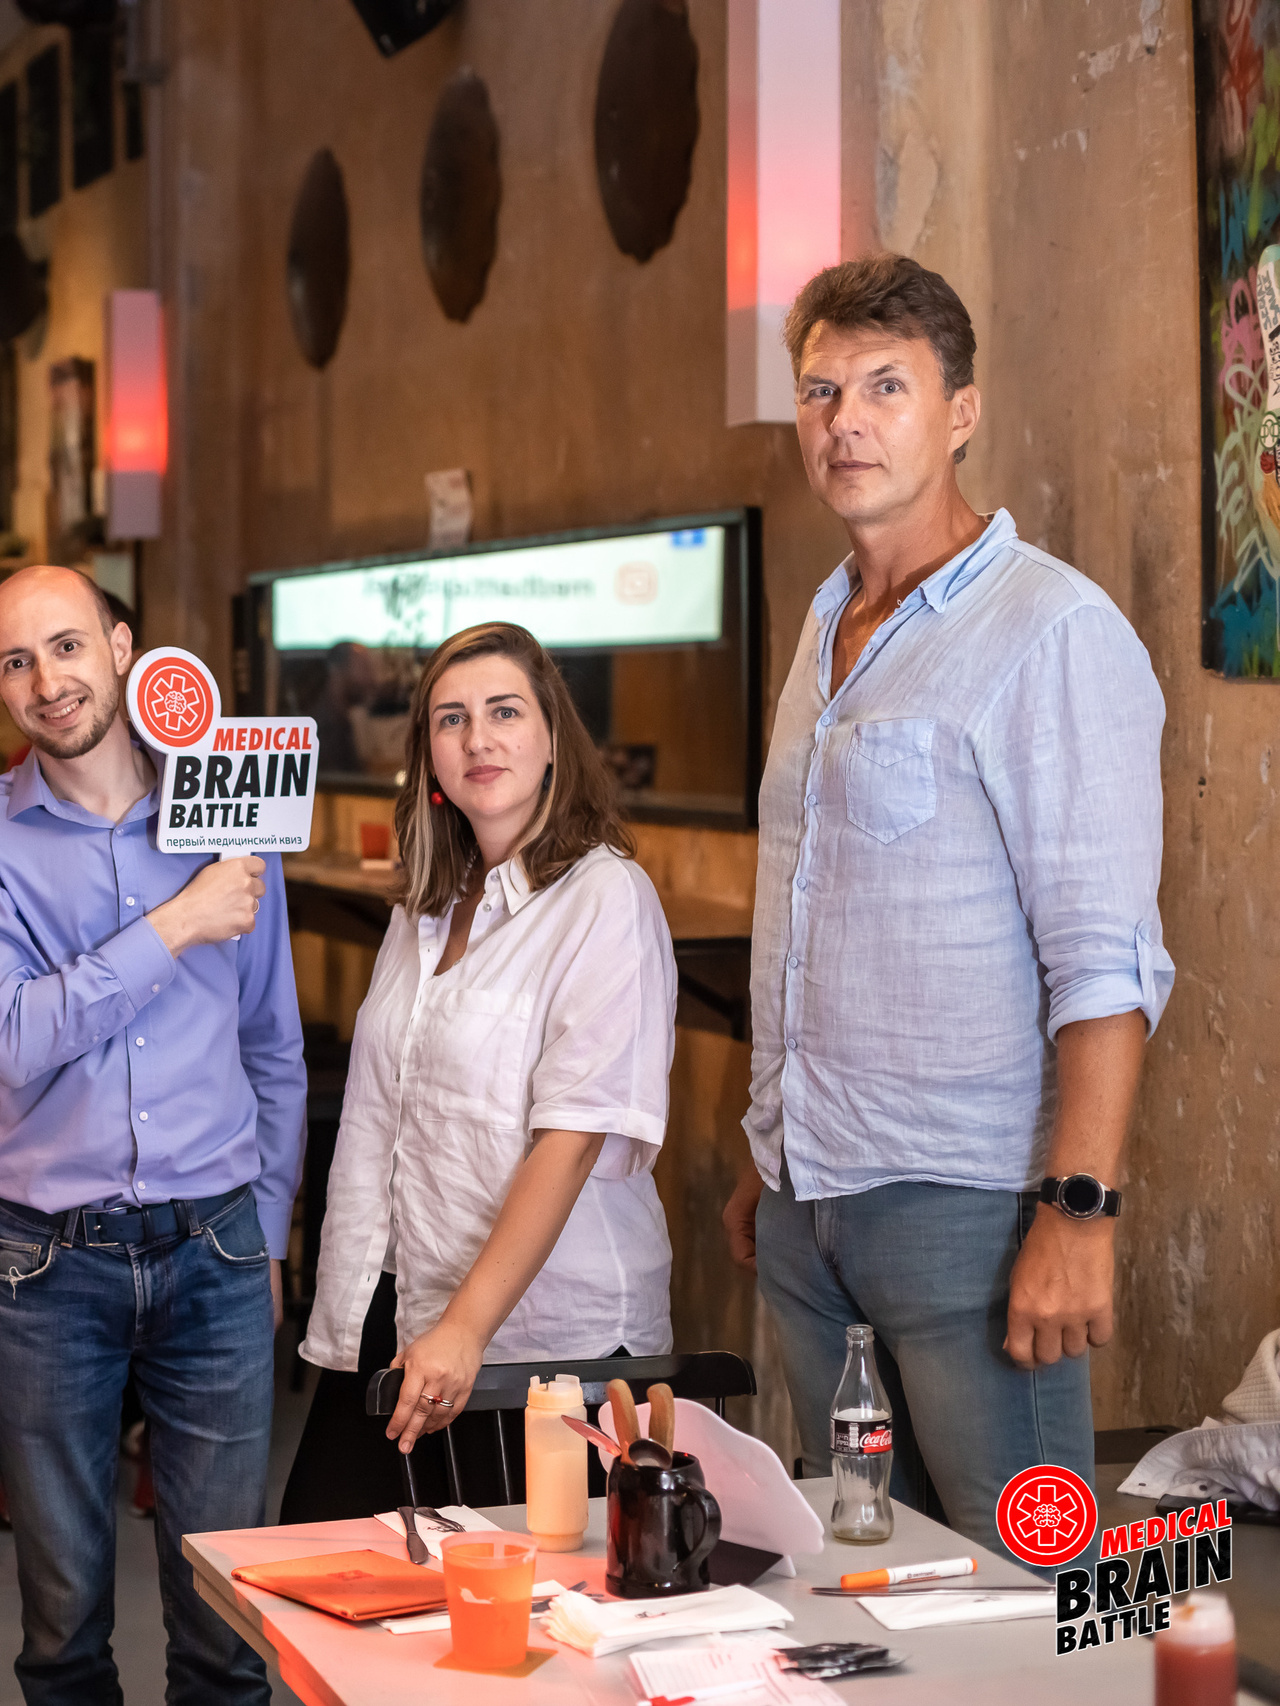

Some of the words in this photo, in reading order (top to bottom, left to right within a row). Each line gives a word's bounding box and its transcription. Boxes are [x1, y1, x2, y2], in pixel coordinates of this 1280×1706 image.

[212, 727, 312, 751] MEDICAL
[172, 753, 311, 800] BRAIN
[169, 803, 259, 828] BATTLE
[166, 835, 206, 848] первый
[208, 834, 277, 847] медицинский
[279, 836, 302, 845] квиз
